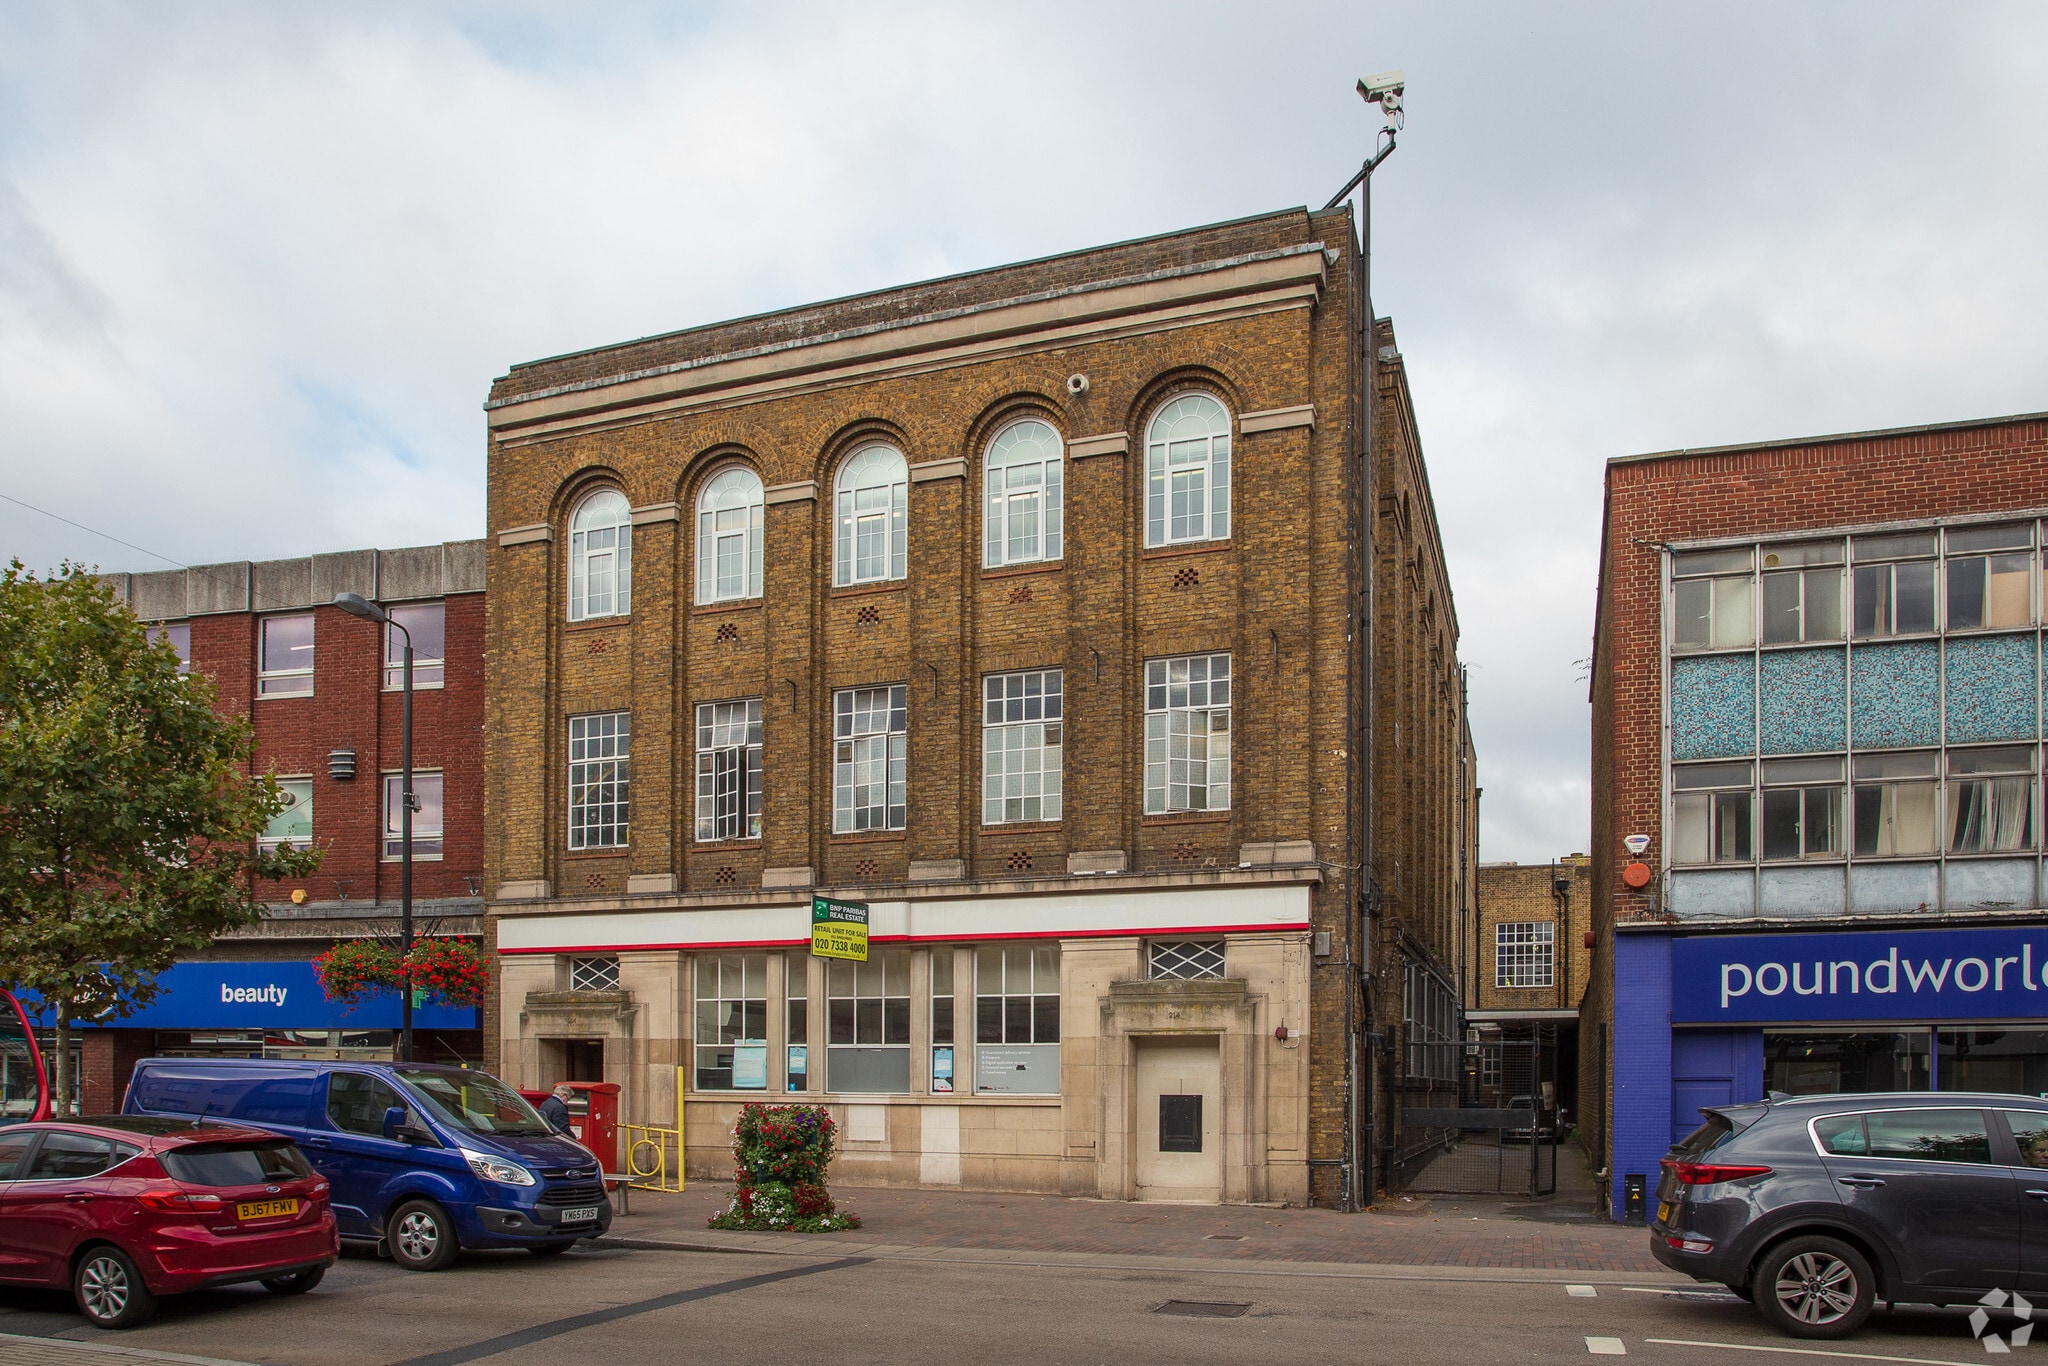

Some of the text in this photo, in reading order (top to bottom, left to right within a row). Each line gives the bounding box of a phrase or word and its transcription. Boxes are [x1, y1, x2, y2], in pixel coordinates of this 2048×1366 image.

[829, 904, 866, 916] BNP PARIBAS
[829, 912, 864, 923] REAL ESTATE
[814, 925, 831, 934] RETAIL
[815, 938, 866, 954] 020 7338 4000
[1721, 943, 2048, 1008] poundworl
[221, 982, 288, 1007] beauty
[242, 1200, 293, 1217] BJ67 FMV
[564, 1208, 595, 1220] YM65 PXS
